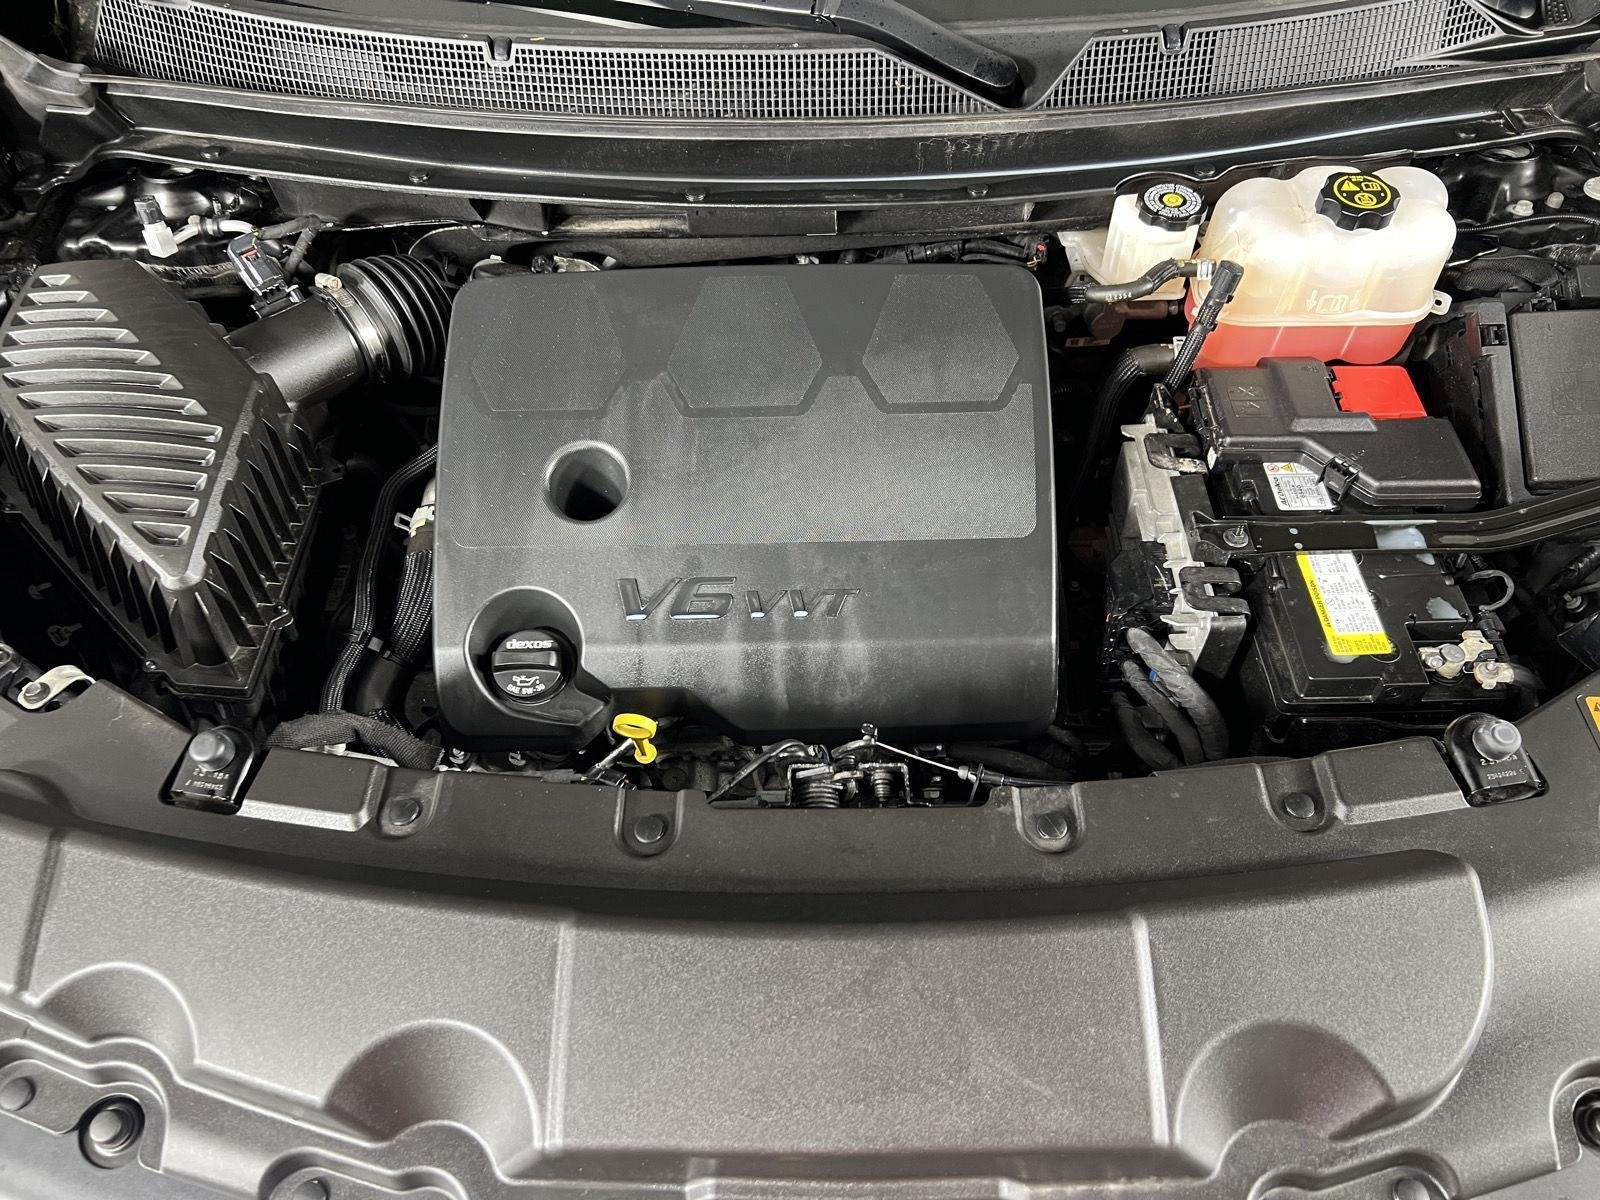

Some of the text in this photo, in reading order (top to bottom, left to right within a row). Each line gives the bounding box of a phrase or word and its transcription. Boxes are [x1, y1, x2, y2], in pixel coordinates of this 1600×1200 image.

[617, 577, 863, 620] V6 VVT
[505, 639, 554, 650] dexos
[506, 683, 546, 695] SAE 5W-30
